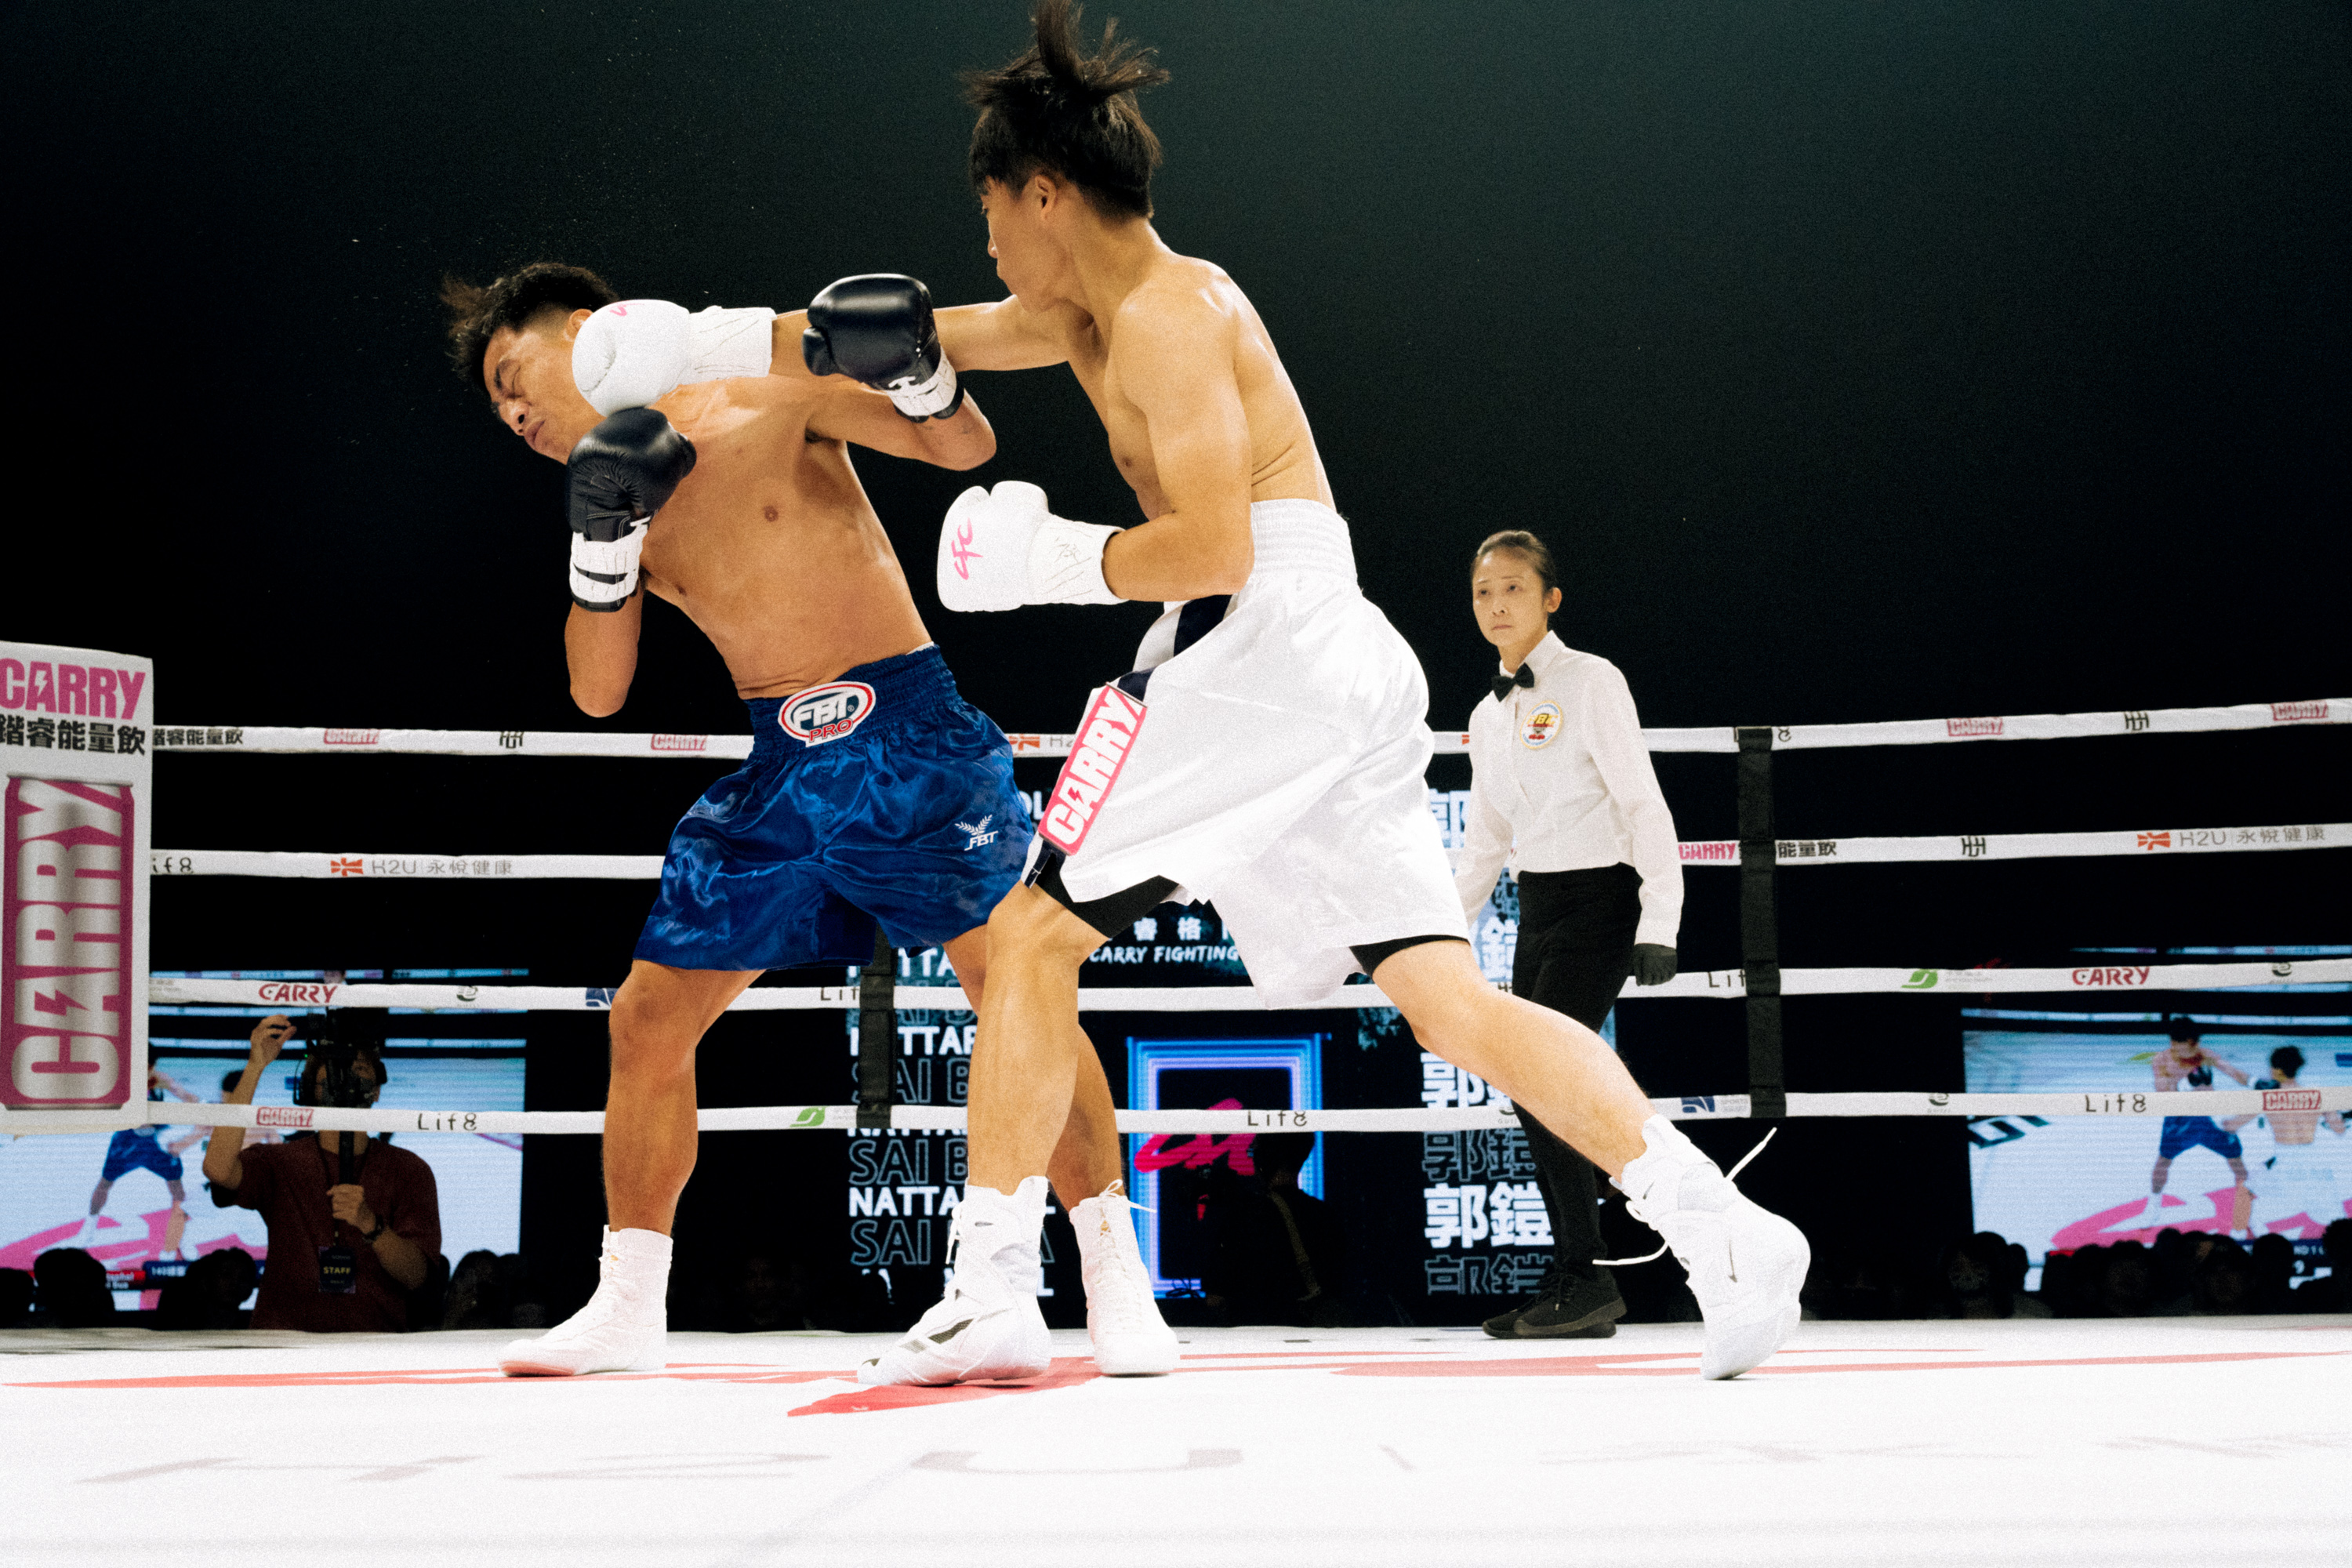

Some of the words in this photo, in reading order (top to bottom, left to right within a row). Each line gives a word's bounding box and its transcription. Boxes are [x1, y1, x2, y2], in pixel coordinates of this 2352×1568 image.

[0, 658, 146, 720] CARRY
[792, 692, 855, 732] FBT
[809, 719, 852, 742] PRO
[1047, 688, 1144, 845] CARRY
[964, 830, 998, 851] FBT
[2180, 831, 2227, 847] H2U
[1679, 843, 1736, 860] CARRY
[1778, 841, 1837, 858] 能量飲
[372, 860, 418, 875] H2U
[11, 779, 122, 1099] CARRY
[1089, 946, 1148, 964] CARRY
[1154, 945, 1239, 964] FIGHTING
[1708, 970, 1746, 988] Lif
[2071, 967, 2151, 986] CARRY
[258, 983, 339, 1004] CARRY
[2264, 1091, 2320, 1110] CARRY
[257, 1107, 314, 1127] CARRY
[848, 1138, 928, 1185] SAI
[848, 1186, 965, 1216] NATTA
[851, 1219, 931, 1265] SAI
[322, 1265, 352, 1276] STAFF
